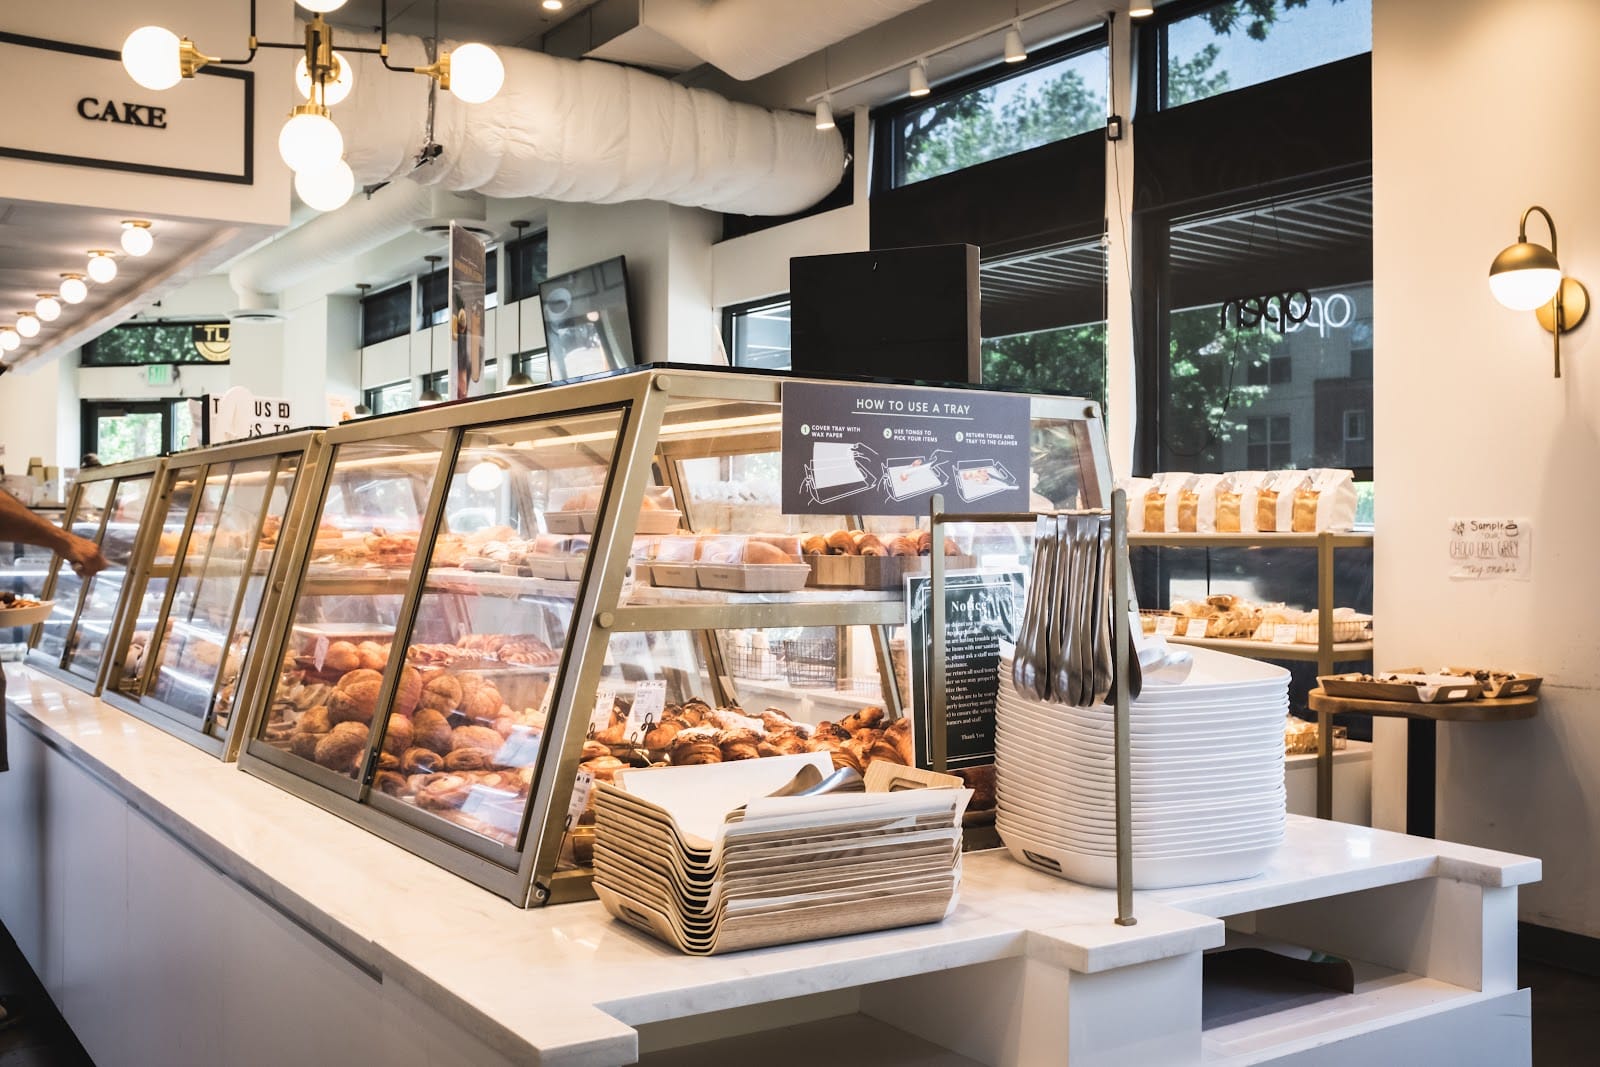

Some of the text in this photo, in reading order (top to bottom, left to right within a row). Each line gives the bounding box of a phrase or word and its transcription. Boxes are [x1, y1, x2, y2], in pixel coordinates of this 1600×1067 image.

[77, 96, 167, 129] CAKE
[856, 398, 970, 415] HOW TO USE A TRAY
[951, 600, 987, 613] Notice
